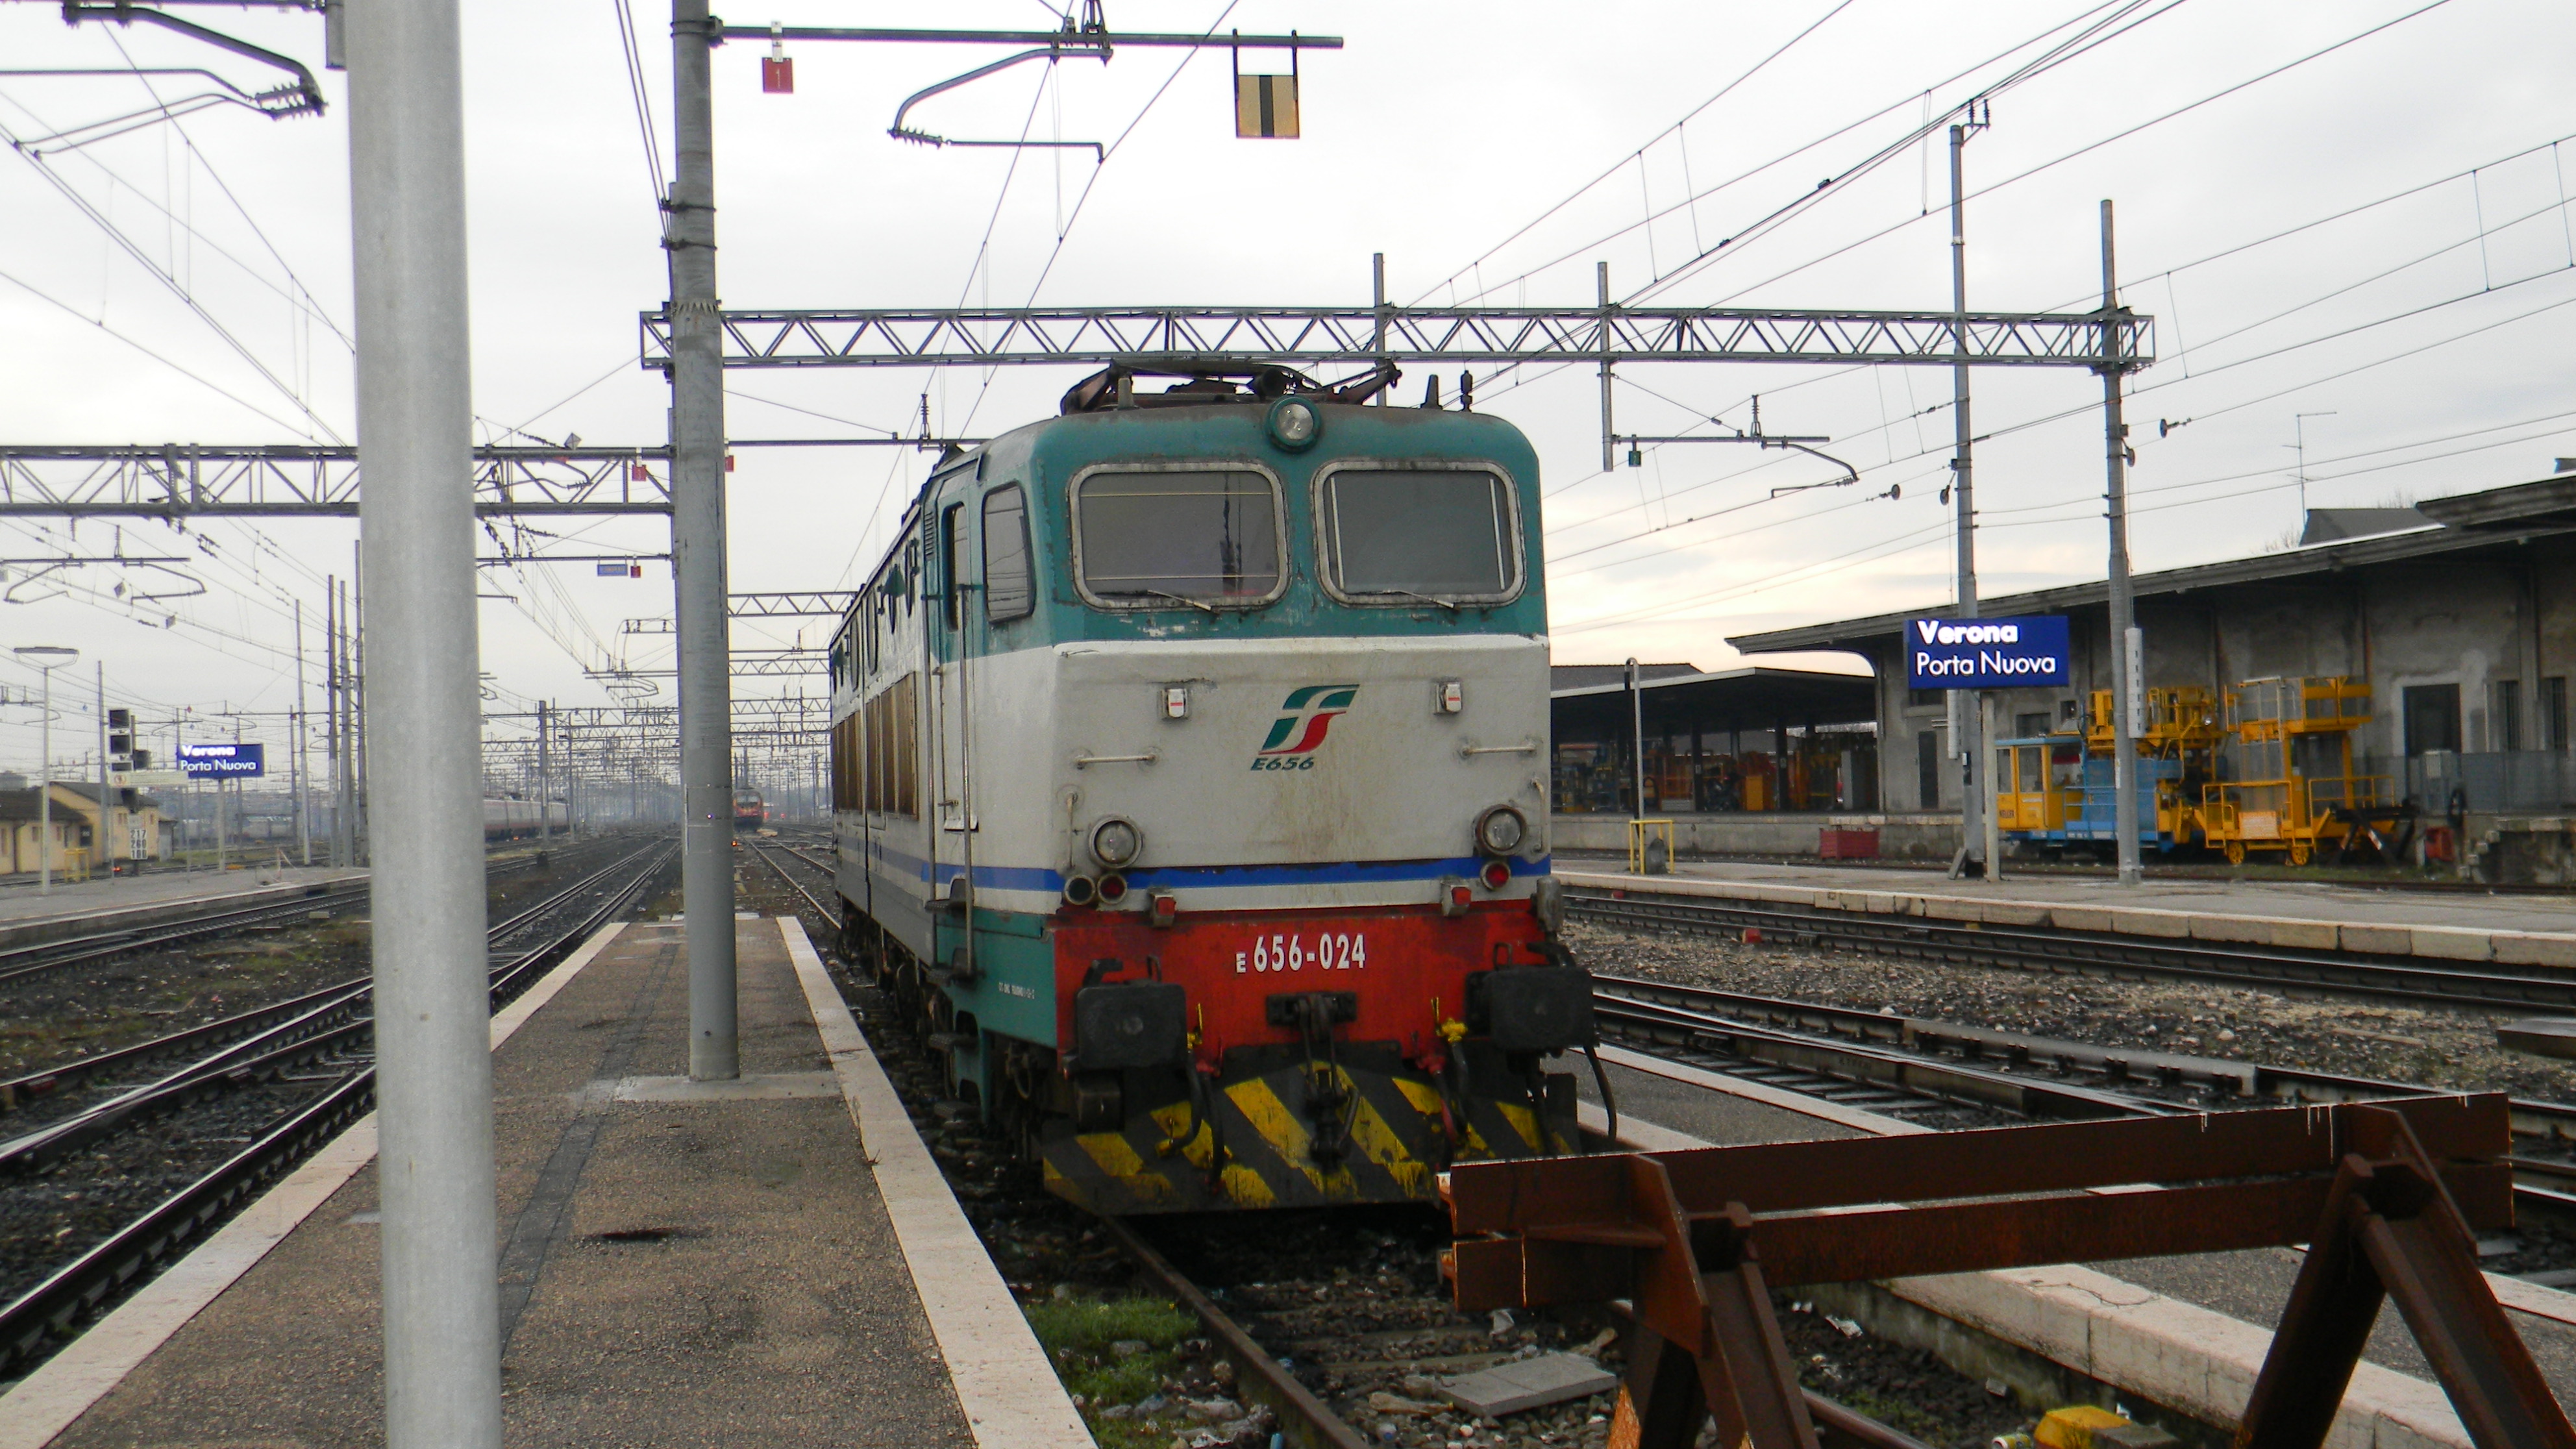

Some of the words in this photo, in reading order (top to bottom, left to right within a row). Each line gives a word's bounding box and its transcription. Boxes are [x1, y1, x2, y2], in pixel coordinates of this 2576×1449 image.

[1917, 620, 2019, 645] Verona
[1916, 652, 1975, 676] Porta
[1980, 650, 2057, 676] Nuova
[182, 745, 236, 757] Verona
[180, 760, 212, 771] Porta
[214, 759, 257, 771] Nuova
[1250, 757, 1315, 771] E656
[130, 830, 147, 839] 217
[1236, 952, 1246, 972] E
[1254, 934, 1366, 972] 656-024
